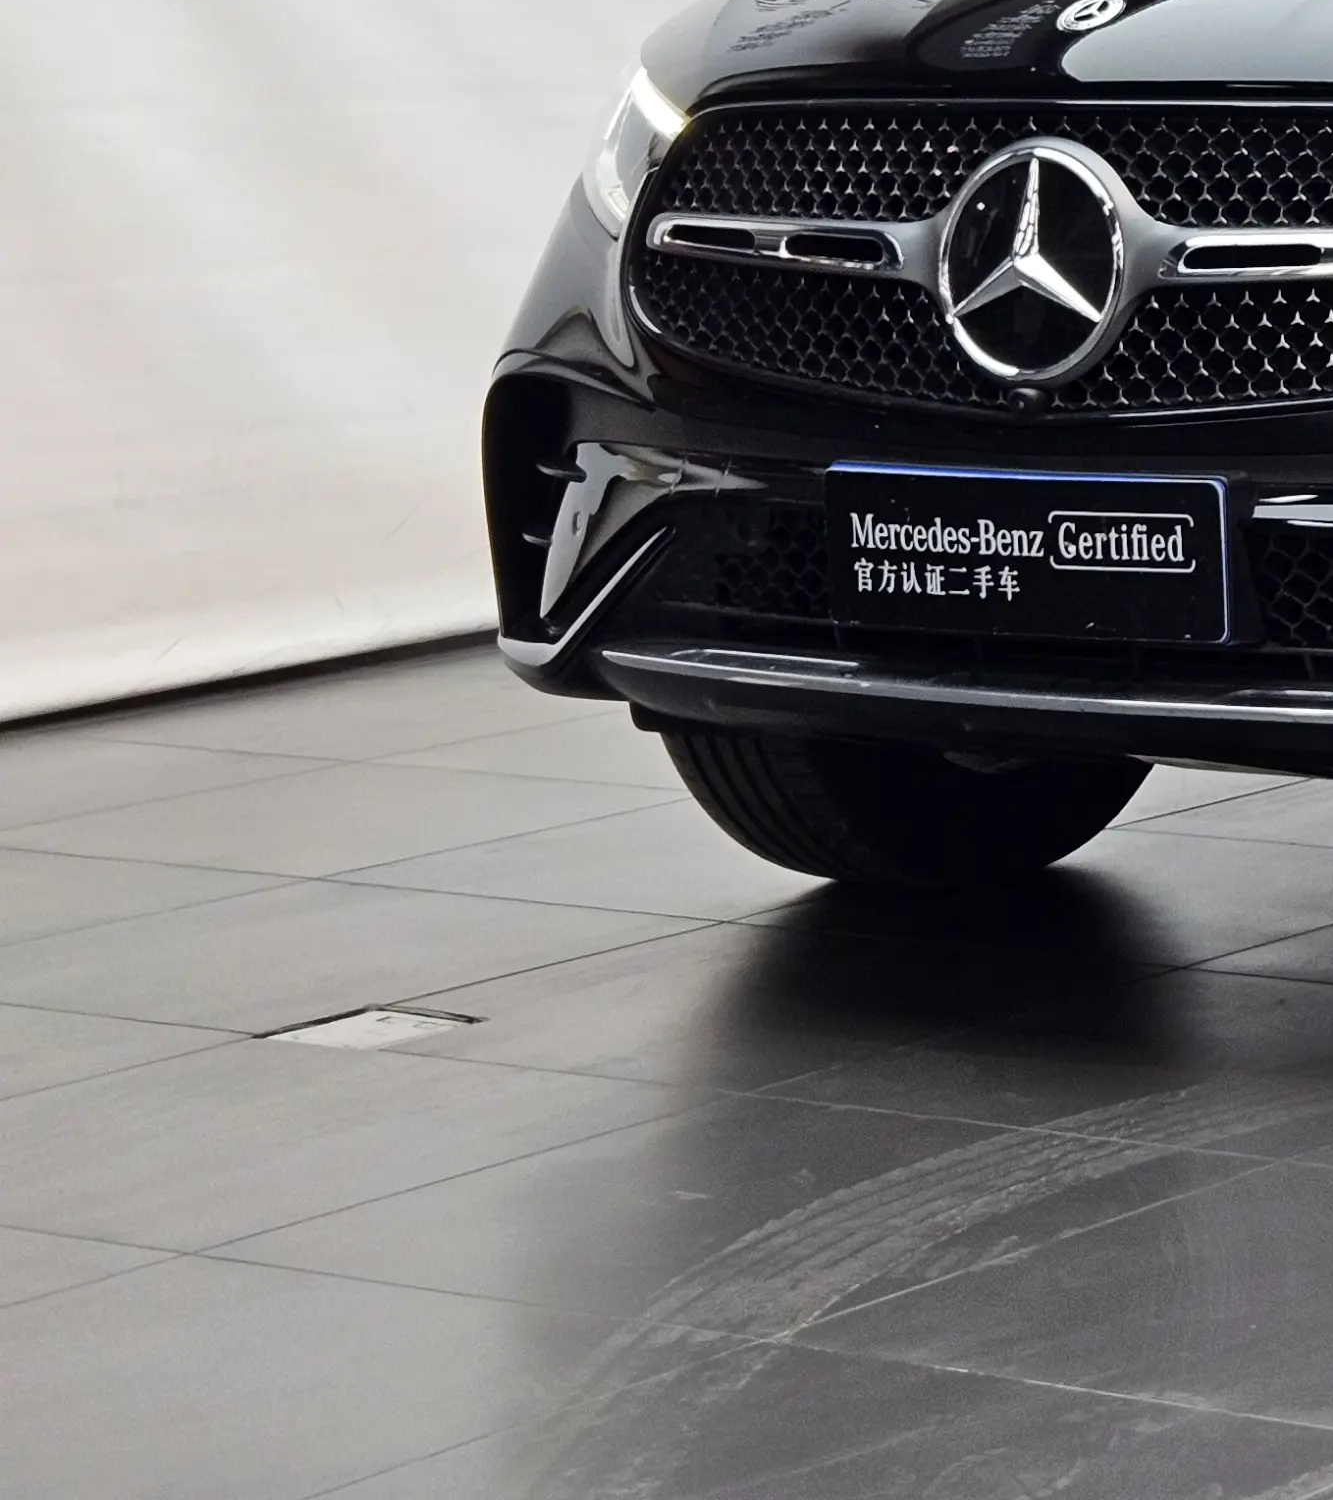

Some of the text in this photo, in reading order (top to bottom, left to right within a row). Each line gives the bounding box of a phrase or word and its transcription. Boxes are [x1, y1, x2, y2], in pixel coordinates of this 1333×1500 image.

[849, 511, 1187, 563] Mercedes-Benz Certified
[852, 556, 1022, 603] 官方认证二手车
